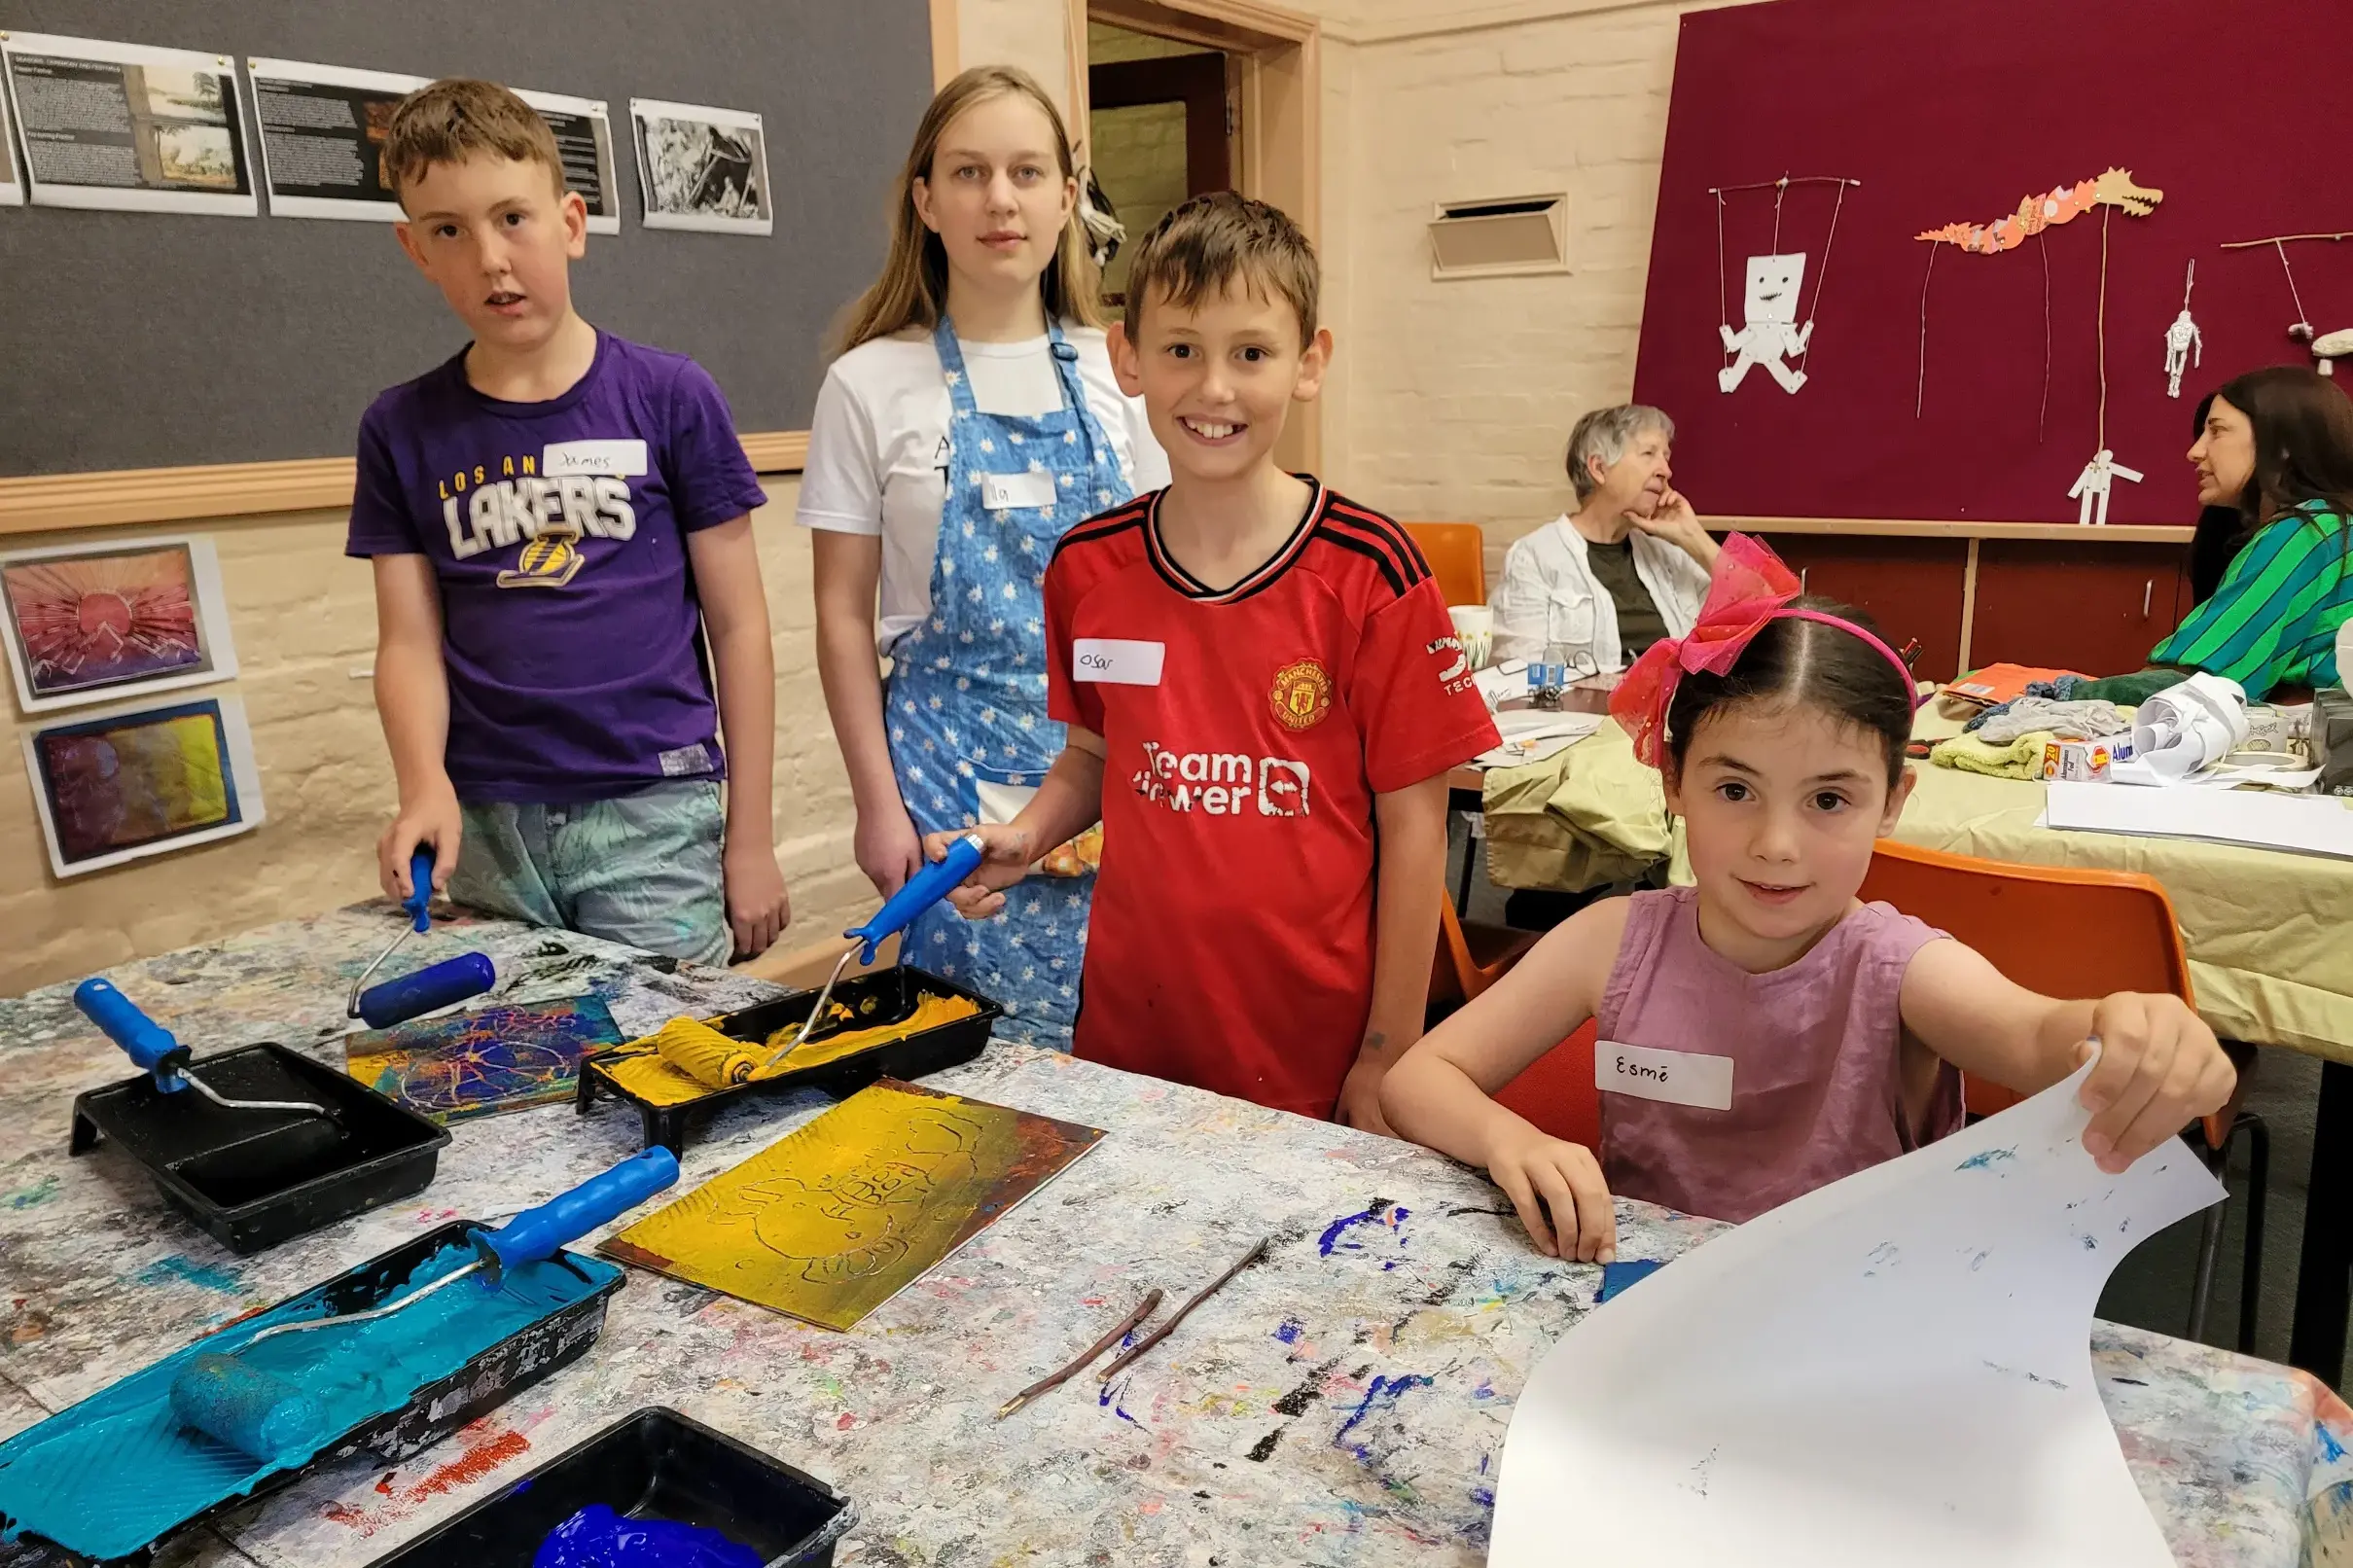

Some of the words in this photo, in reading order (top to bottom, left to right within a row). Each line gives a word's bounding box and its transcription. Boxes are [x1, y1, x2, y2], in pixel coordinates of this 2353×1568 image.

[439, 465, 485, 500] LOS
[443, 475, 637, 560] LAKERS
[1280, 667, 1329, 693] MANCHESTER
[1282, 710, 1316, 724] UNITED
[1142, 741, 1253, 783] Team
